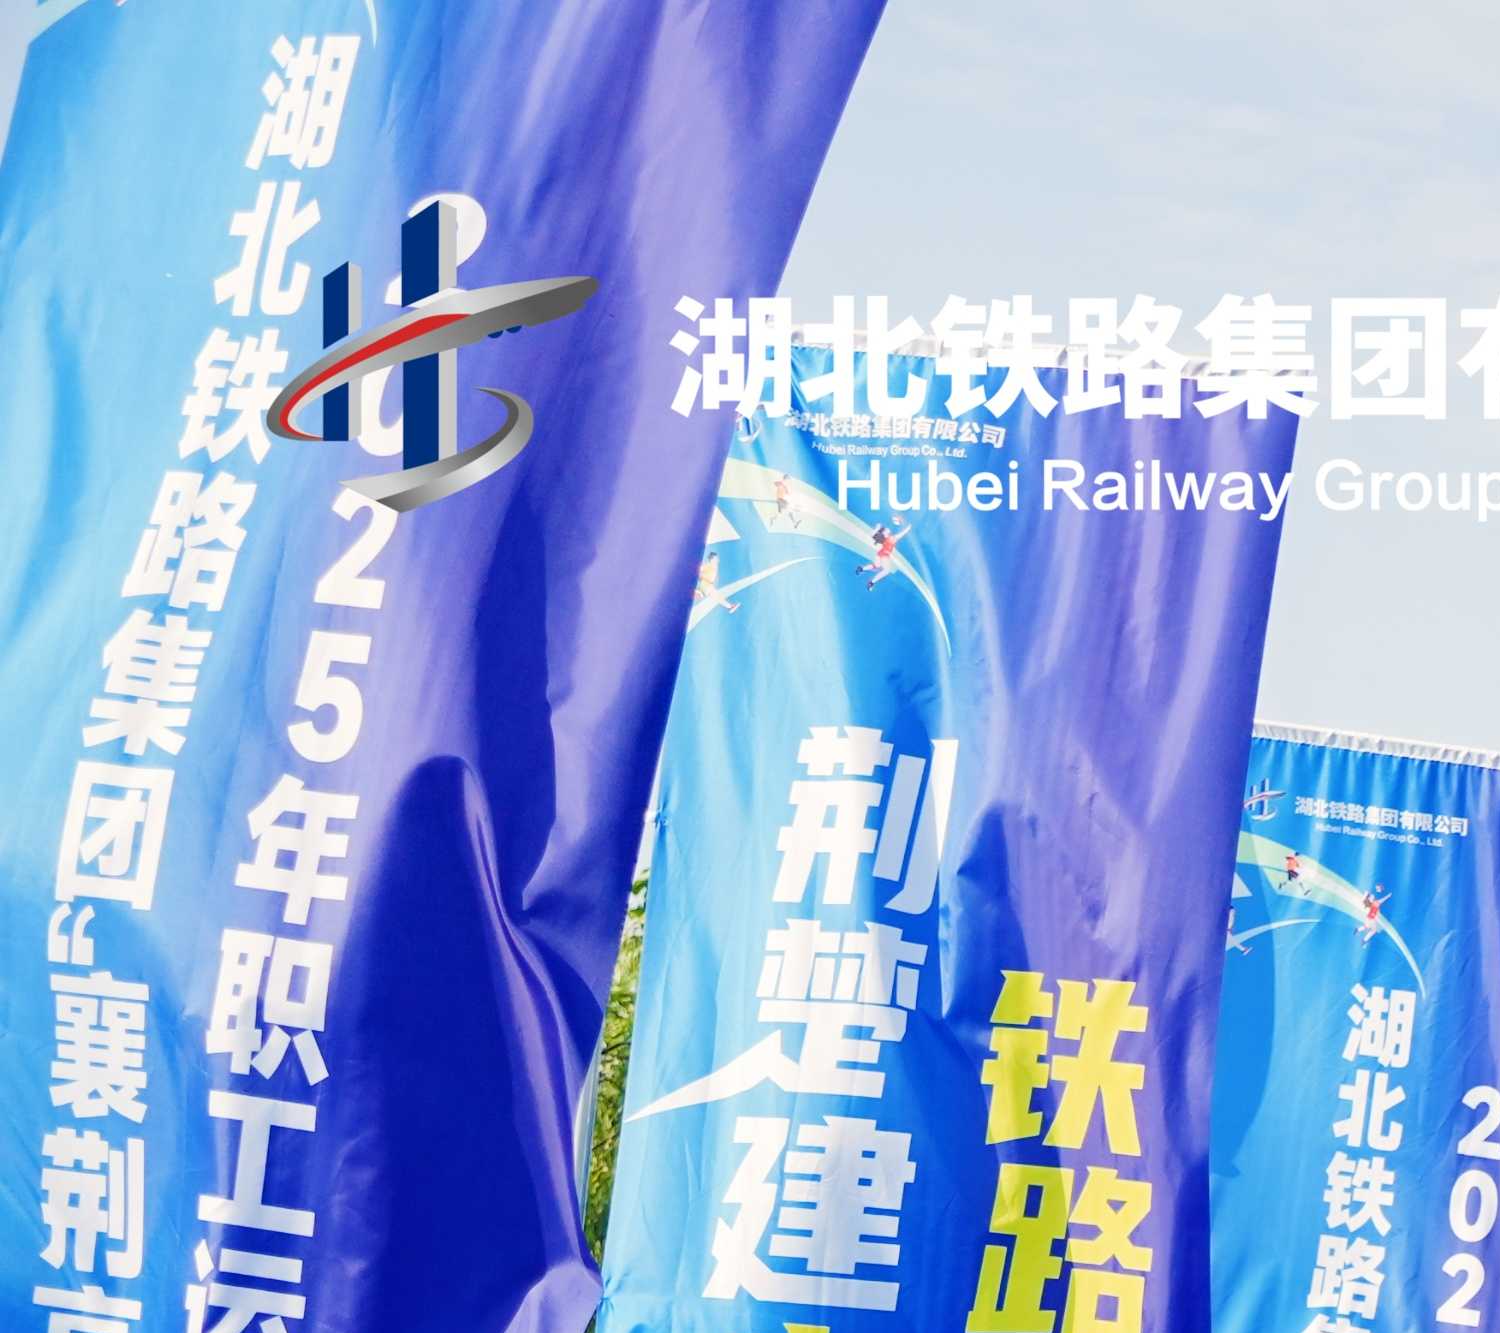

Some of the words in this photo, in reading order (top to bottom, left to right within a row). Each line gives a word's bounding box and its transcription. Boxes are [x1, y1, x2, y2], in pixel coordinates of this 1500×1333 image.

[1295, 796, 1469, 837] 湖北铁路集团有限公司
